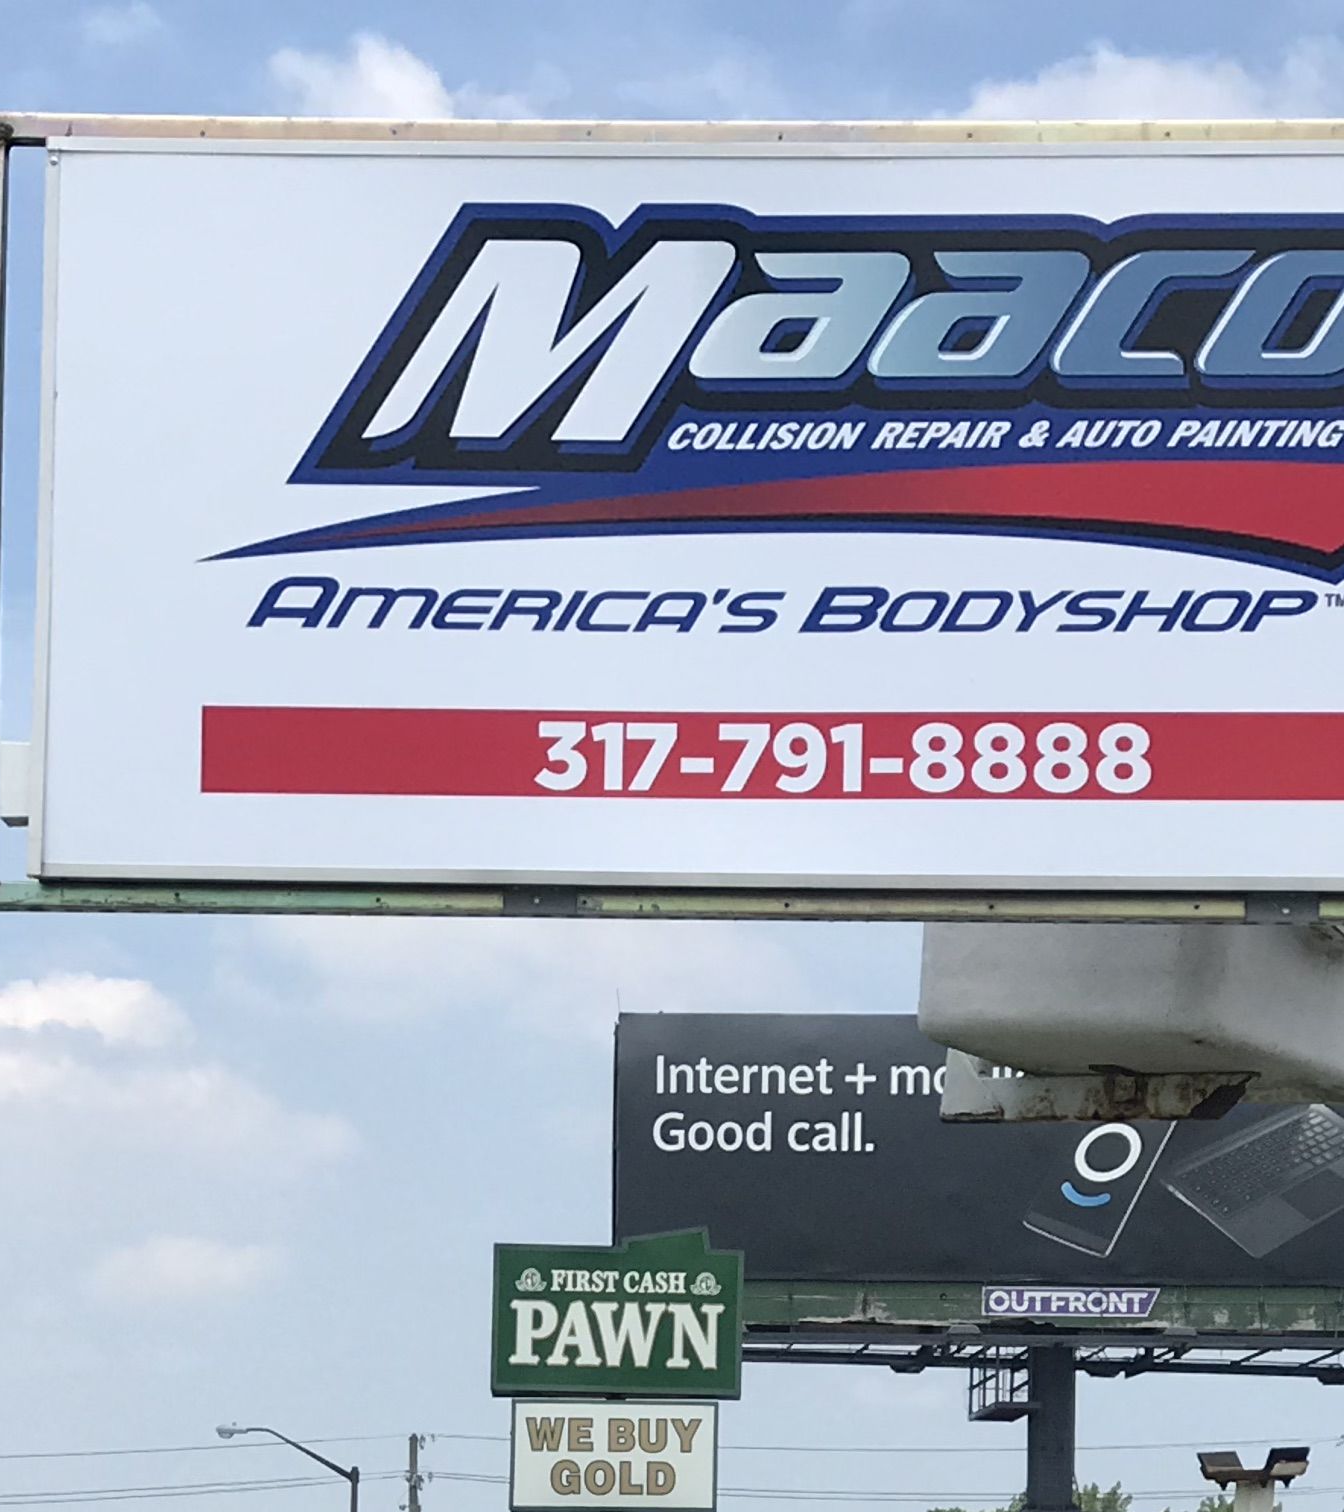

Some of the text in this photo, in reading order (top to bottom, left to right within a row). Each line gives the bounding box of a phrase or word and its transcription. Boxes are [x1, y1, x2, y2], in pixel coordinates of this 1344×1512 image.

[668, 422, 863, 451] COLLISION
[871, 421, 1008, 449] REPAIR
[1017, 420, 1051, 448] &
[1055, 420, 1159, 448] AUTO
[246, 576, 779, 633] AMERICA'S
[797, 587, 1318, 633] BODYSHOP
[533, 721, 1153, 794] 317-791-8888
[656, 1055, 833, 1095] Internet
[652, 1111, 875, 1152] Good call.
[550, 1269, 687, 1294] FIRST CASH
[988, 1290, 1147, 1314] OUTFRONT
[508, 1299, 726, 1370] PAWN
[525, 1417, 703, 1453] WE BUY
[550, 1459, 676, 1496] GOLD
